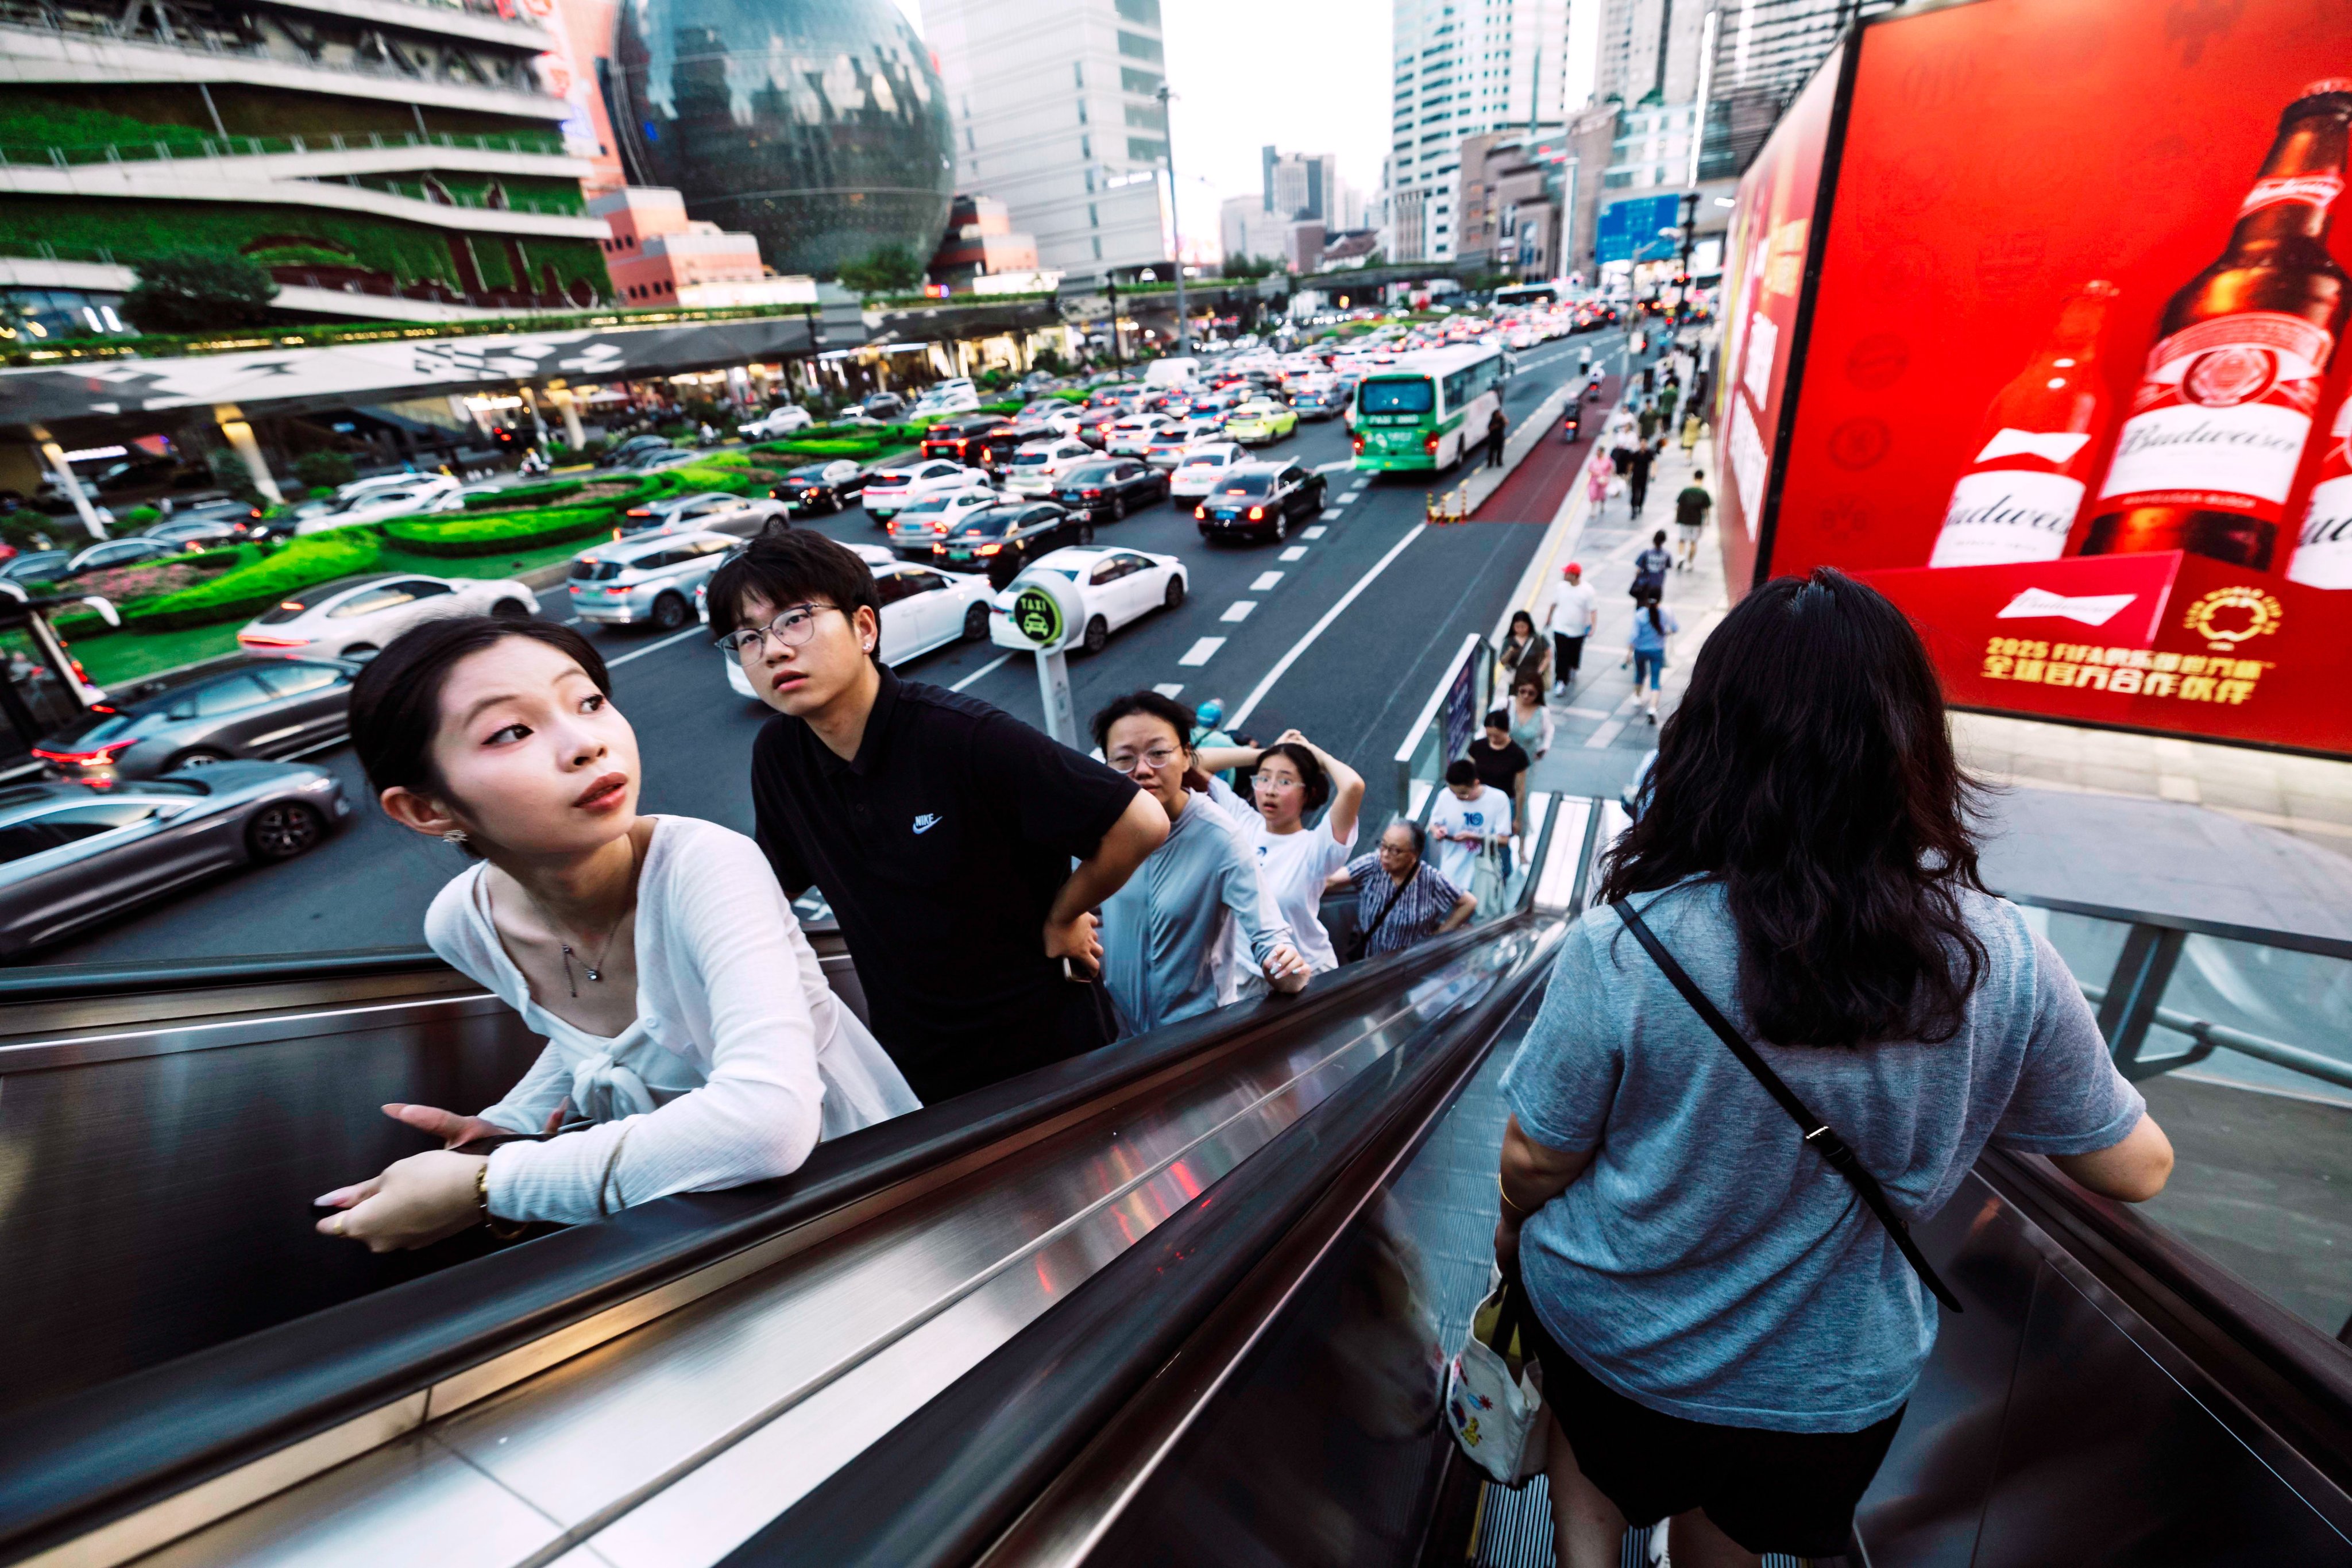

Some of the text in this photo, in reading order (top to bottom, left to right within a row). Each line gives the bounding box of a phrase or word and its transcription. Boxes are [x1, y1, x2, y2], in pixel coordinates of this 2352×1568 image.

[1020, 597, 1046, 612] TAXI
[1986, 636, 2049, 659] 2025
[914, 813, 934, 827] NIKE
